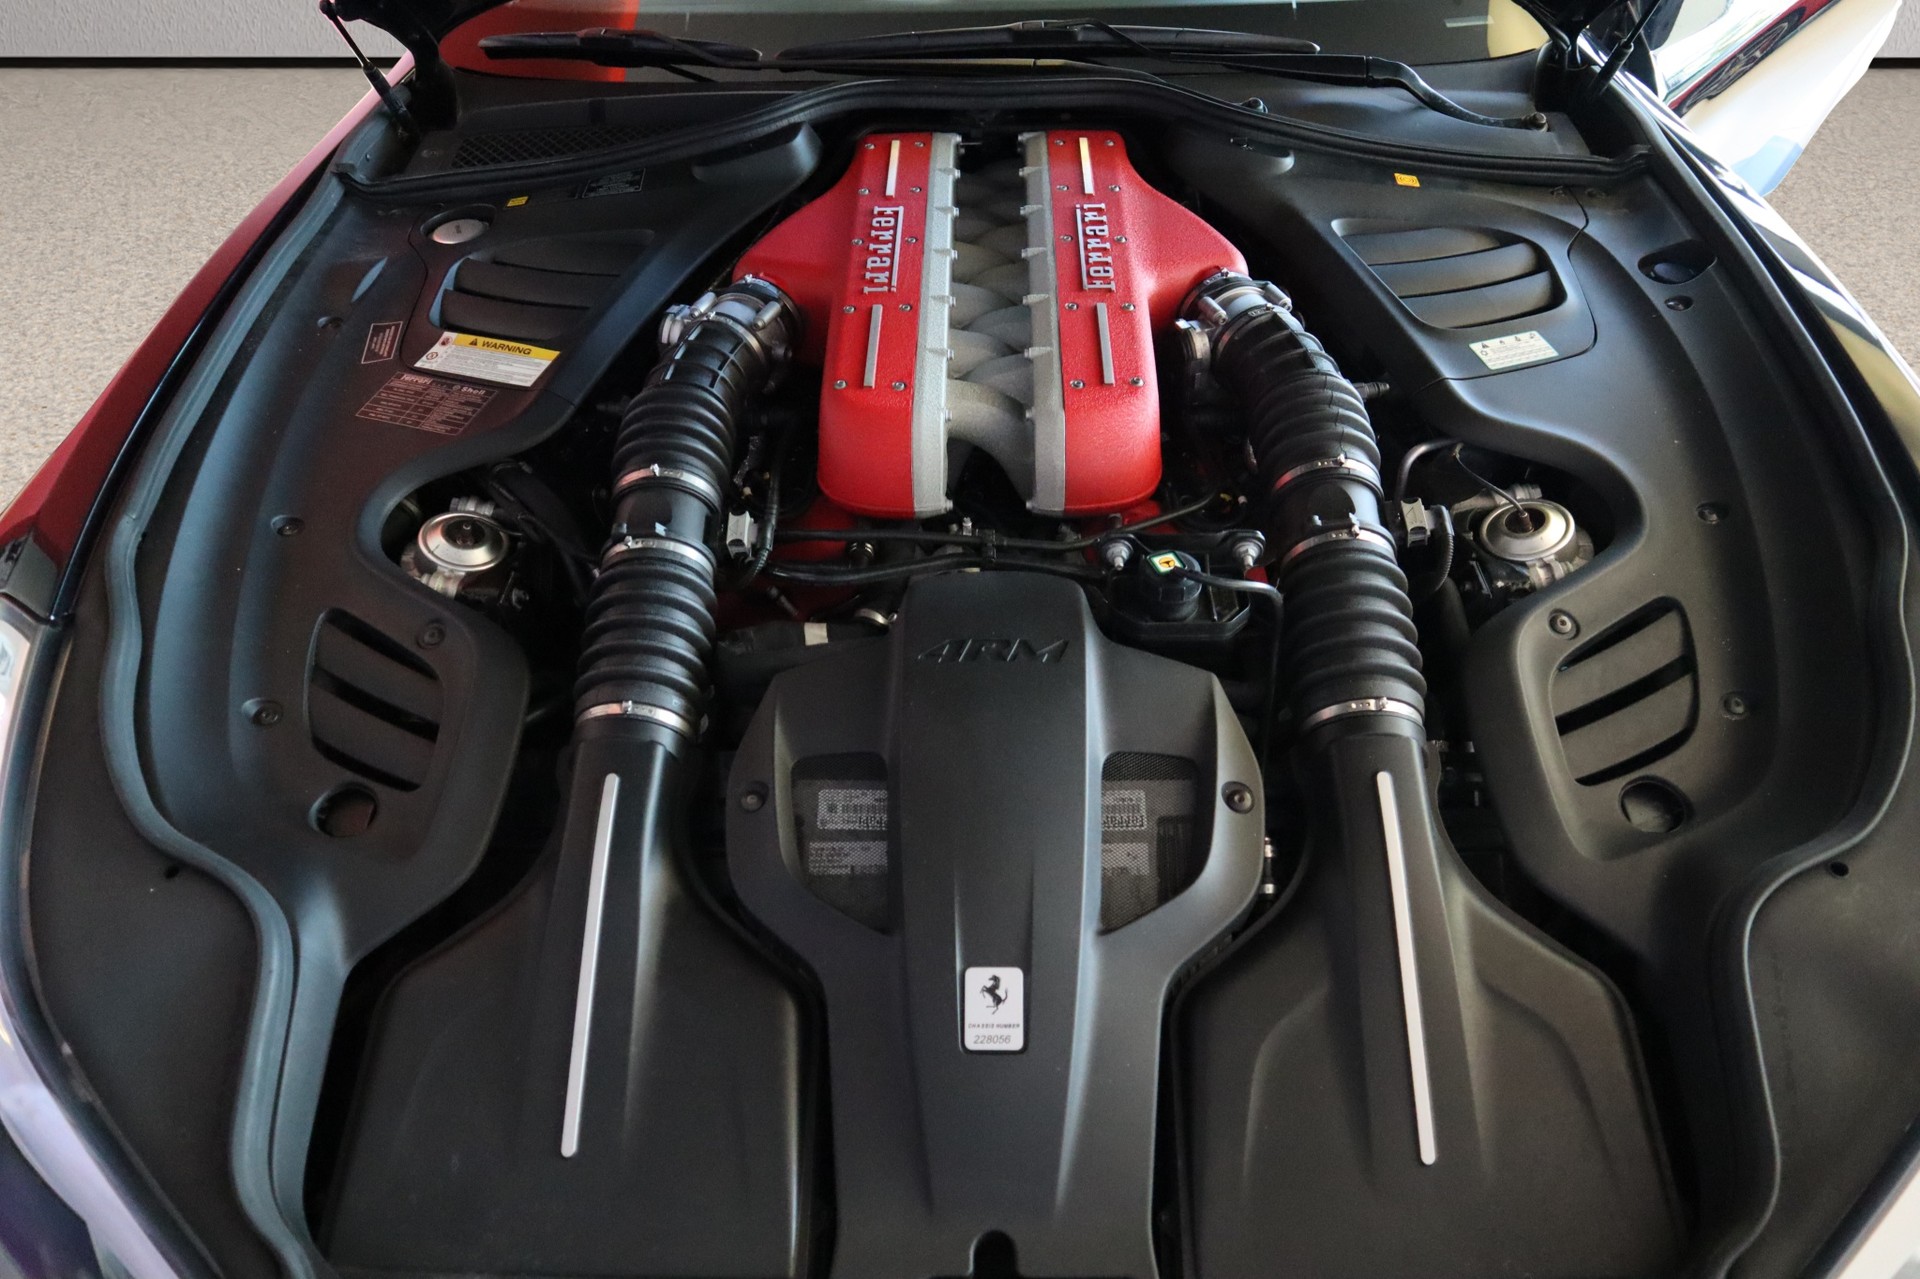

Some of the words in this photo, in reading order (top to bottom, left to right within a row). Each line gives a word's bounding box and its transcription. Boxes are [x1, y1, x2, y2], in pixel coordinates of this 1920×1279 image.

[864, 206, 904, 293] Ferrari
[1075, 202, 1116, 292] Ferrari
[482, 340, 532, 355] WARNING
[461, 386, 487, 395] Shell
[915, 638, 1070, 663] 4RM
[973, 1034, 1012, 1045] 228056
